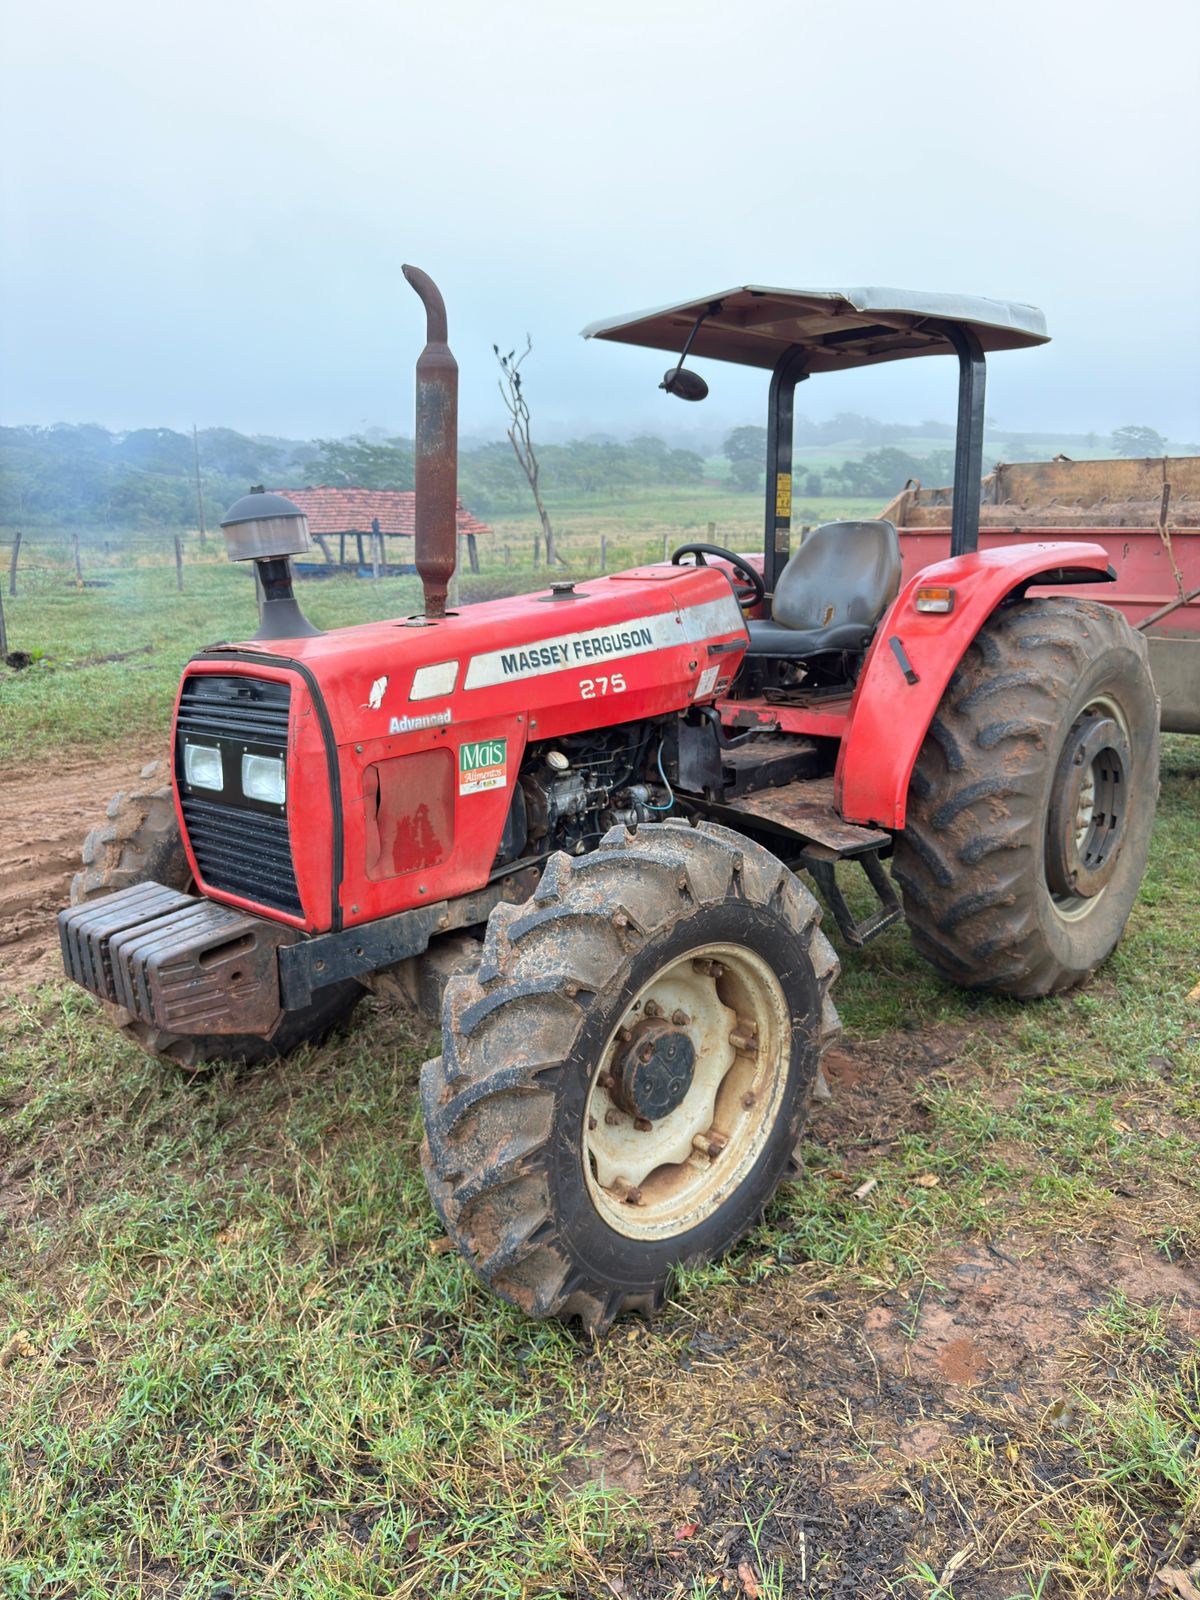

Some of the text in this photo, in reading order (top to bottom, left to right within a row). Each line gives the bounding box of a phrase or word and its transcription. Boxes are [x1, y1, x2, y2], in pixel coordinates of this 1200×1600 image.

[501, 628, 653, 674] MASSEY FERGUSON
[579, 673, 627, 700] 275
[389, 707, 452, 735] Advanced
[463, 741, 503, 770] Mais
